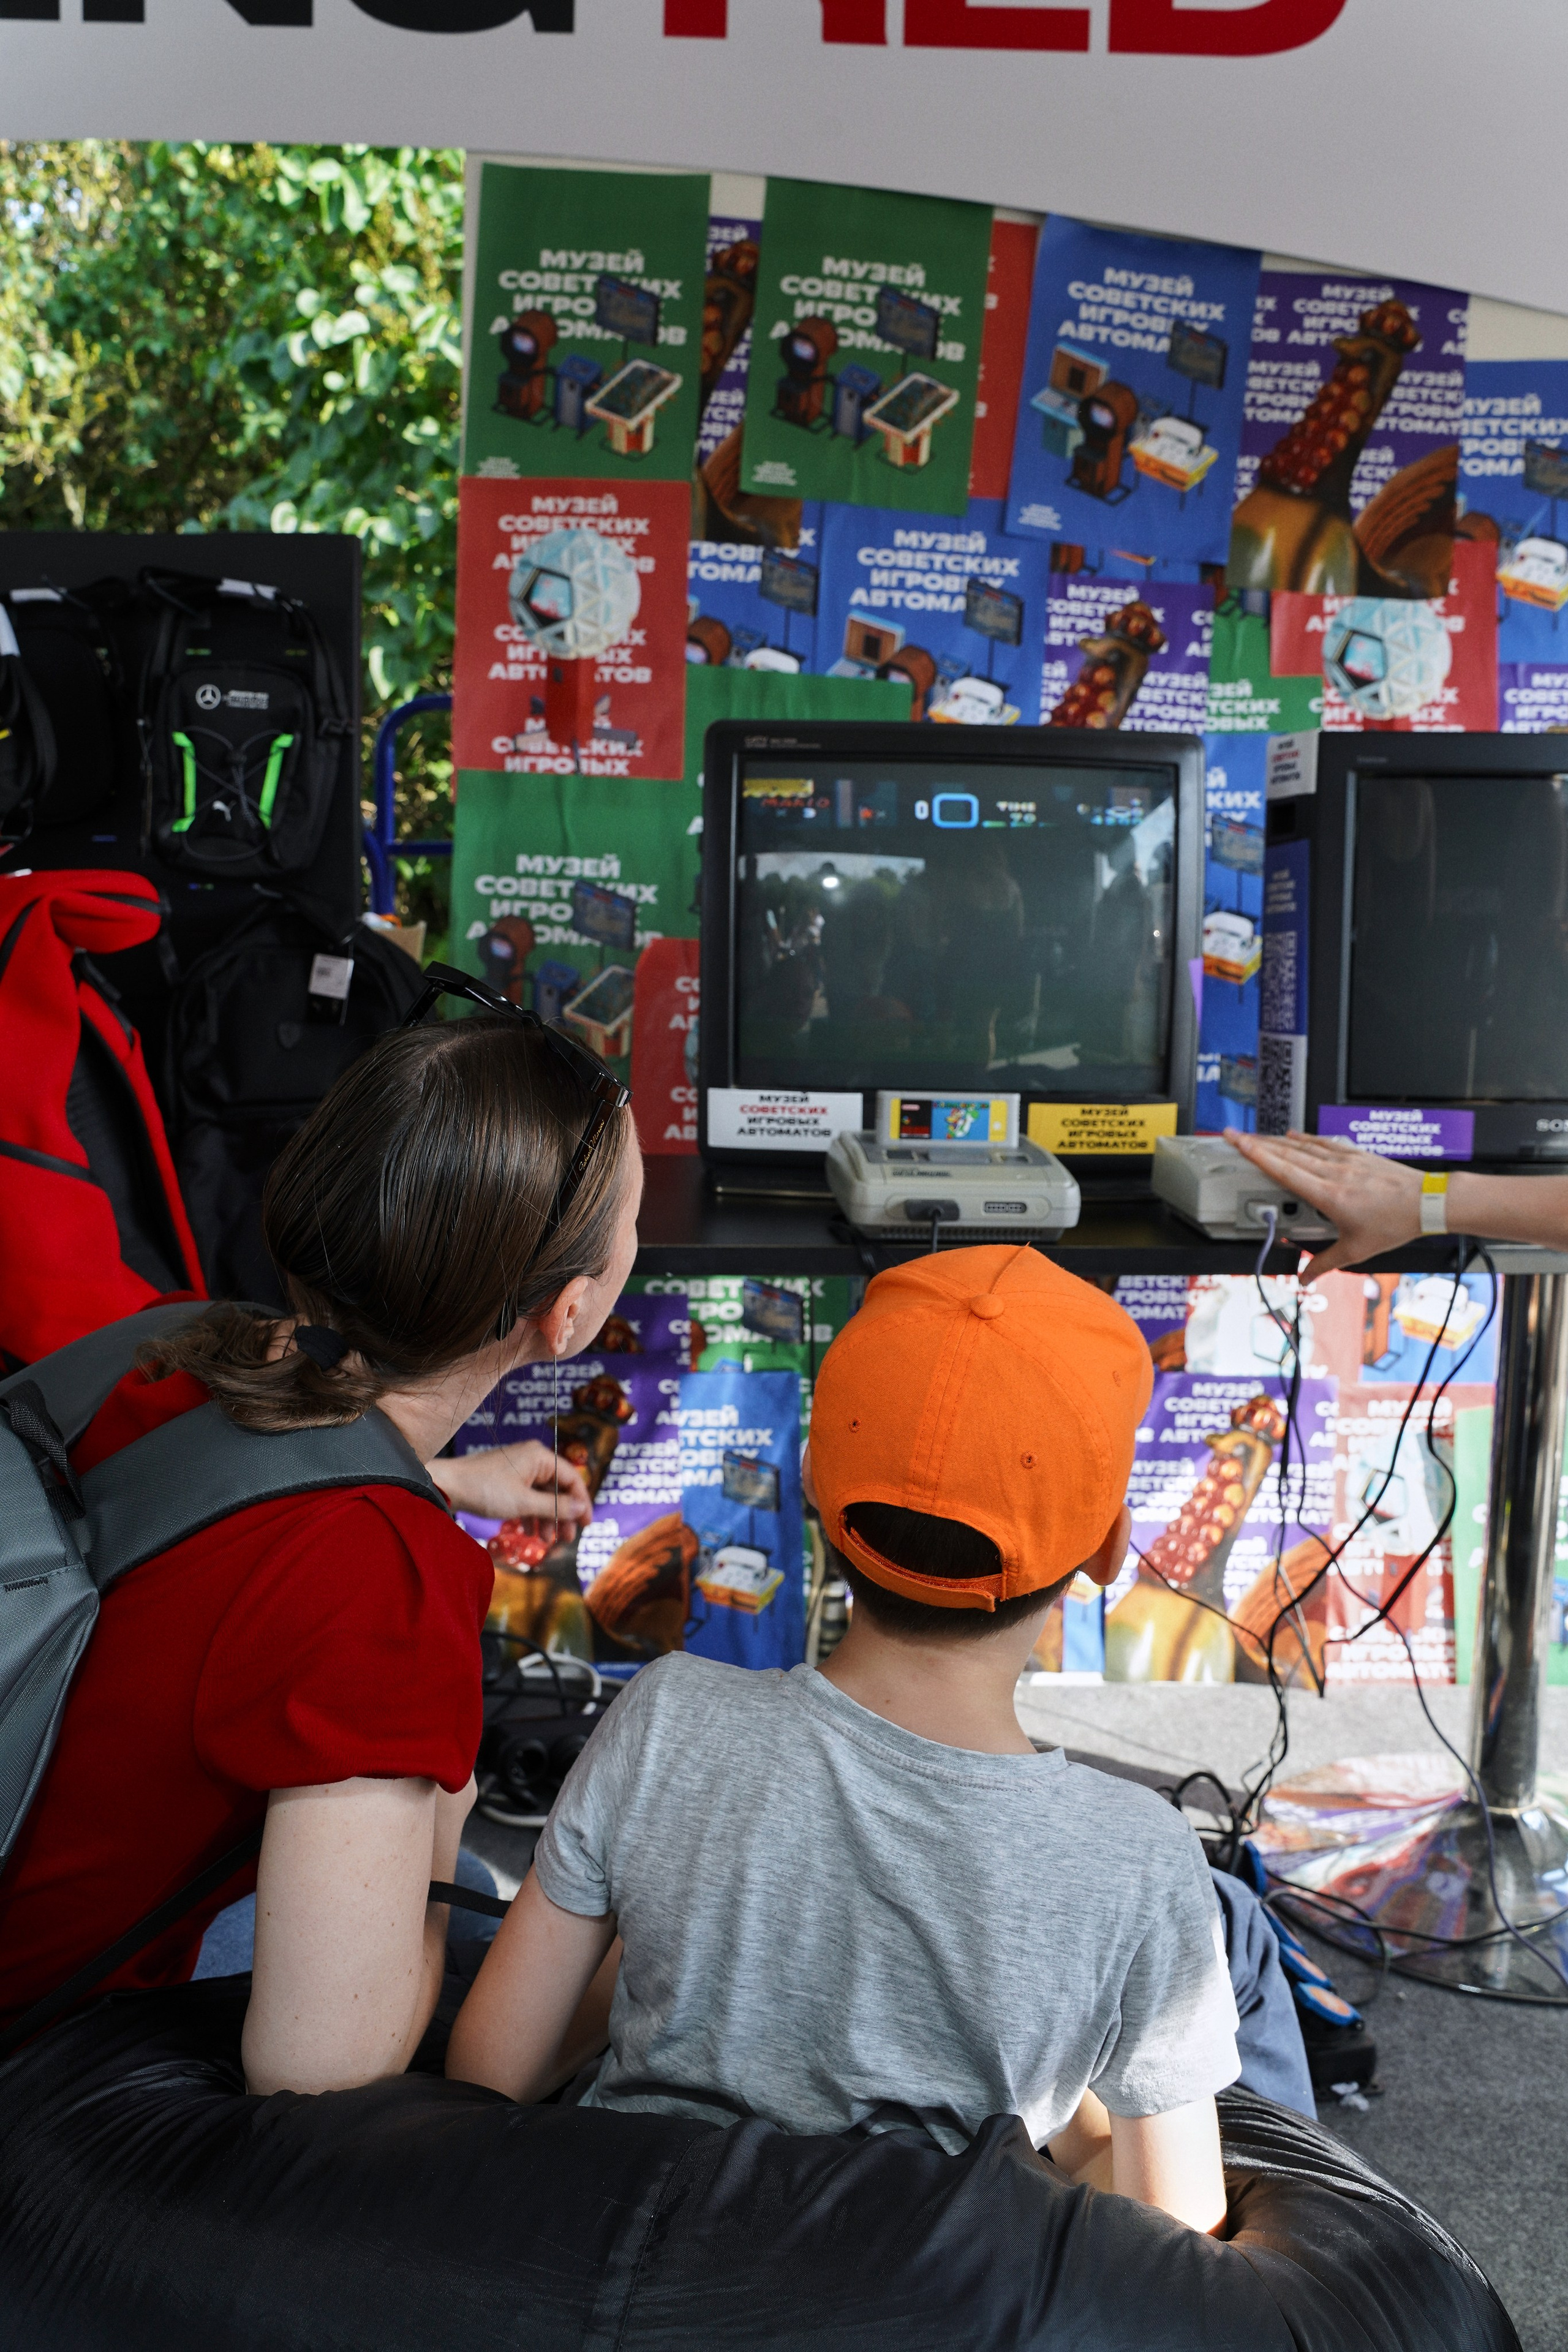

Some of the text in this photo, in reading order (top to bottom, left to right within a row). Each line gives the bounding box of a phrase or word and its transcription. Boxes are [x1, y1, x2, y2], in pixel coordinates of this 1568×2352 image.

[540, 249, 645, 274] МУЗЕЙ
[822, 256, 926, 287] МУЗЕЙ
[498, 270, 683, 299] СОВЕТИХ
[1103, 266, 1194, 298] МУЗЕЙ
[780, 274, 962, 317] СОВЕТИХ
[1067, 281, 1226, 322] СОВЕТСКИХ
[1321, 283, 1395, 302] МУЗЕЙ
[531, 493, 619, 514] МУЗЕЙ
[498, 514, 650, 535] СОВЕТСКИХ
[894, 529, 987, 554] МУЗЕЙ
[857, 546, 1020, 577] СОВЕТСКИХ
[1067, 584, 1139, 604] МУЗЕЙ
[516, 853, 621, 879] МУЗЕЙ
[474, 874, 659, 904] СОВЕТИХ
[739, 1104, 828, 1115] СОВЕТСКИХ
[1369, 1109, 1423, 1122] МУЗЕЙ
[747, 1116, 820, 1125] ИГРОВЫХ
[1061, 1118, 1145, 1128] СОВЕТСКИХ
[1349, 1120, 1441, 1135] СОВЕТСКИХ
[737, 1127, 832, 1137] АВТОМАТОВ
[1068, 1129, 1137, 1138] ИГРОВЫХ
[1356, 1133, 1433, 1145] ИГРОВЫХ
[1058, 1140, 1148, 1149] АВТОМАТОВ
[1192, 1380, 1265, 1397] МУЗЕЙ
